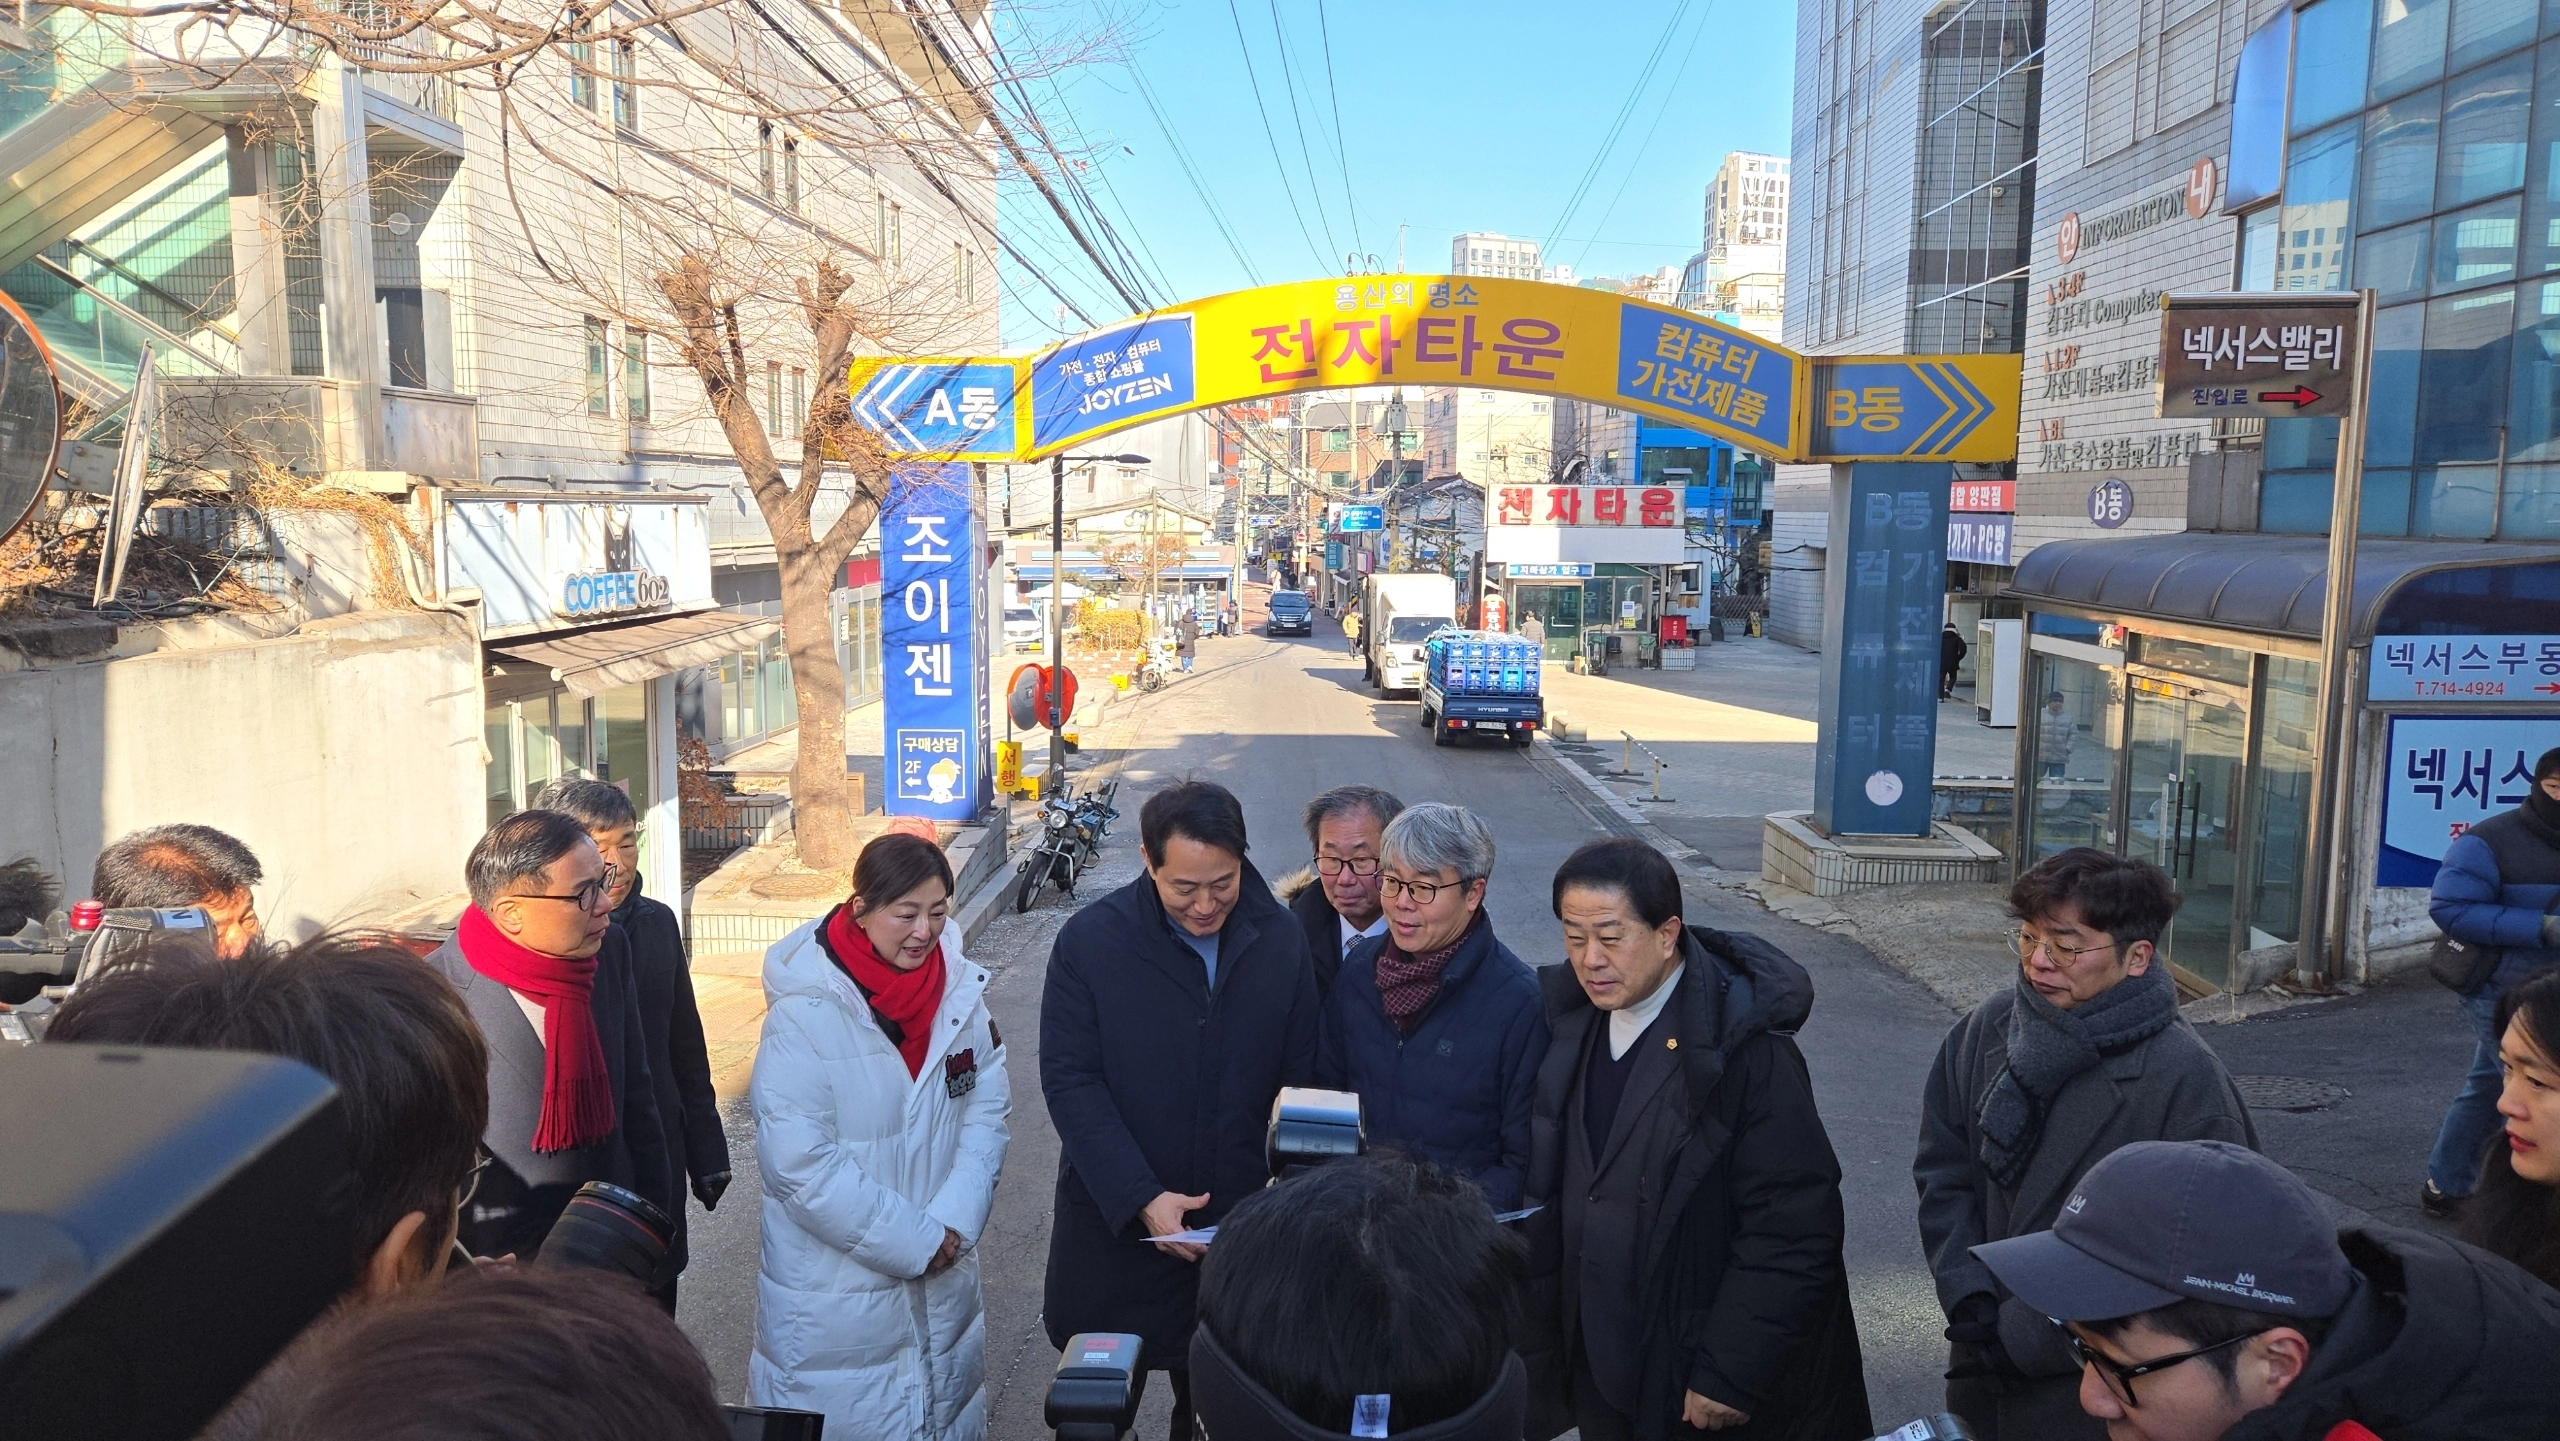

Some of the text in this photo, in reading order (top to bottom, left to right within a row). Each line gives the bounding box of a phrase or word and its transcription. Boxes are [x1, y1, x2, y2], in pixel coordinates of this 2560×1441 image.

[2061, 162, 2213, 258] 안 INFORMATION 내
[1334, 281, 1480, 311] 용산의 명소
[2047, 288, 2162, 337] 컴퓨터 Computer
[1059, 360, 1084, 376] 가전
[1093, 351, 1117, 369] 전자
[1127, 338, 1161, 359] 컴퓨터
[1250, 314, 1565, 384] 전자타운
[1656, 323, 1760, 383] 컴퓨터
[2183, 325, 2343, 371] 넥서스밸리
[1083, 359, 1144, 387] 종합 쇼핑몰
[923, 387, 999, 430] A동
[1078, 373, 1173, 415] JOYZEN
[1632, 360, 1768, 428] 가전제품
[1826, 387, 1904, 432] B동
[2192, 387, 2249, 406] 진입로
[1498, 487, 1675, 527] 전자타운
[1866, 491, 1932, 531] B동
[1969, 486, 2001, 507] 양판점
[2094, 487, 2123, 521] B동
[1520, 565, 1579, 575] 지하상가 입구
[564, 570, 670, 613] COFFEE 602
[902, 516, 952, 697] 조이젠
[976, 548, 988, 780] JOYZEN
[1892, 550, 1938, 751] 가전제품
[2386, 642, 2560, 676] 넥서스부동
[2415, 682, 2504, 695] T.714-4924
[903, 737, 959, 754] 구매상담
[904, 760, 922, 775] 2F
[1001, 748, 1016, 787] 서행
[2407, 748, 2536, 810] 넥서스
[2184, 1275, 2250, 1296] JEAN-MICHEL
